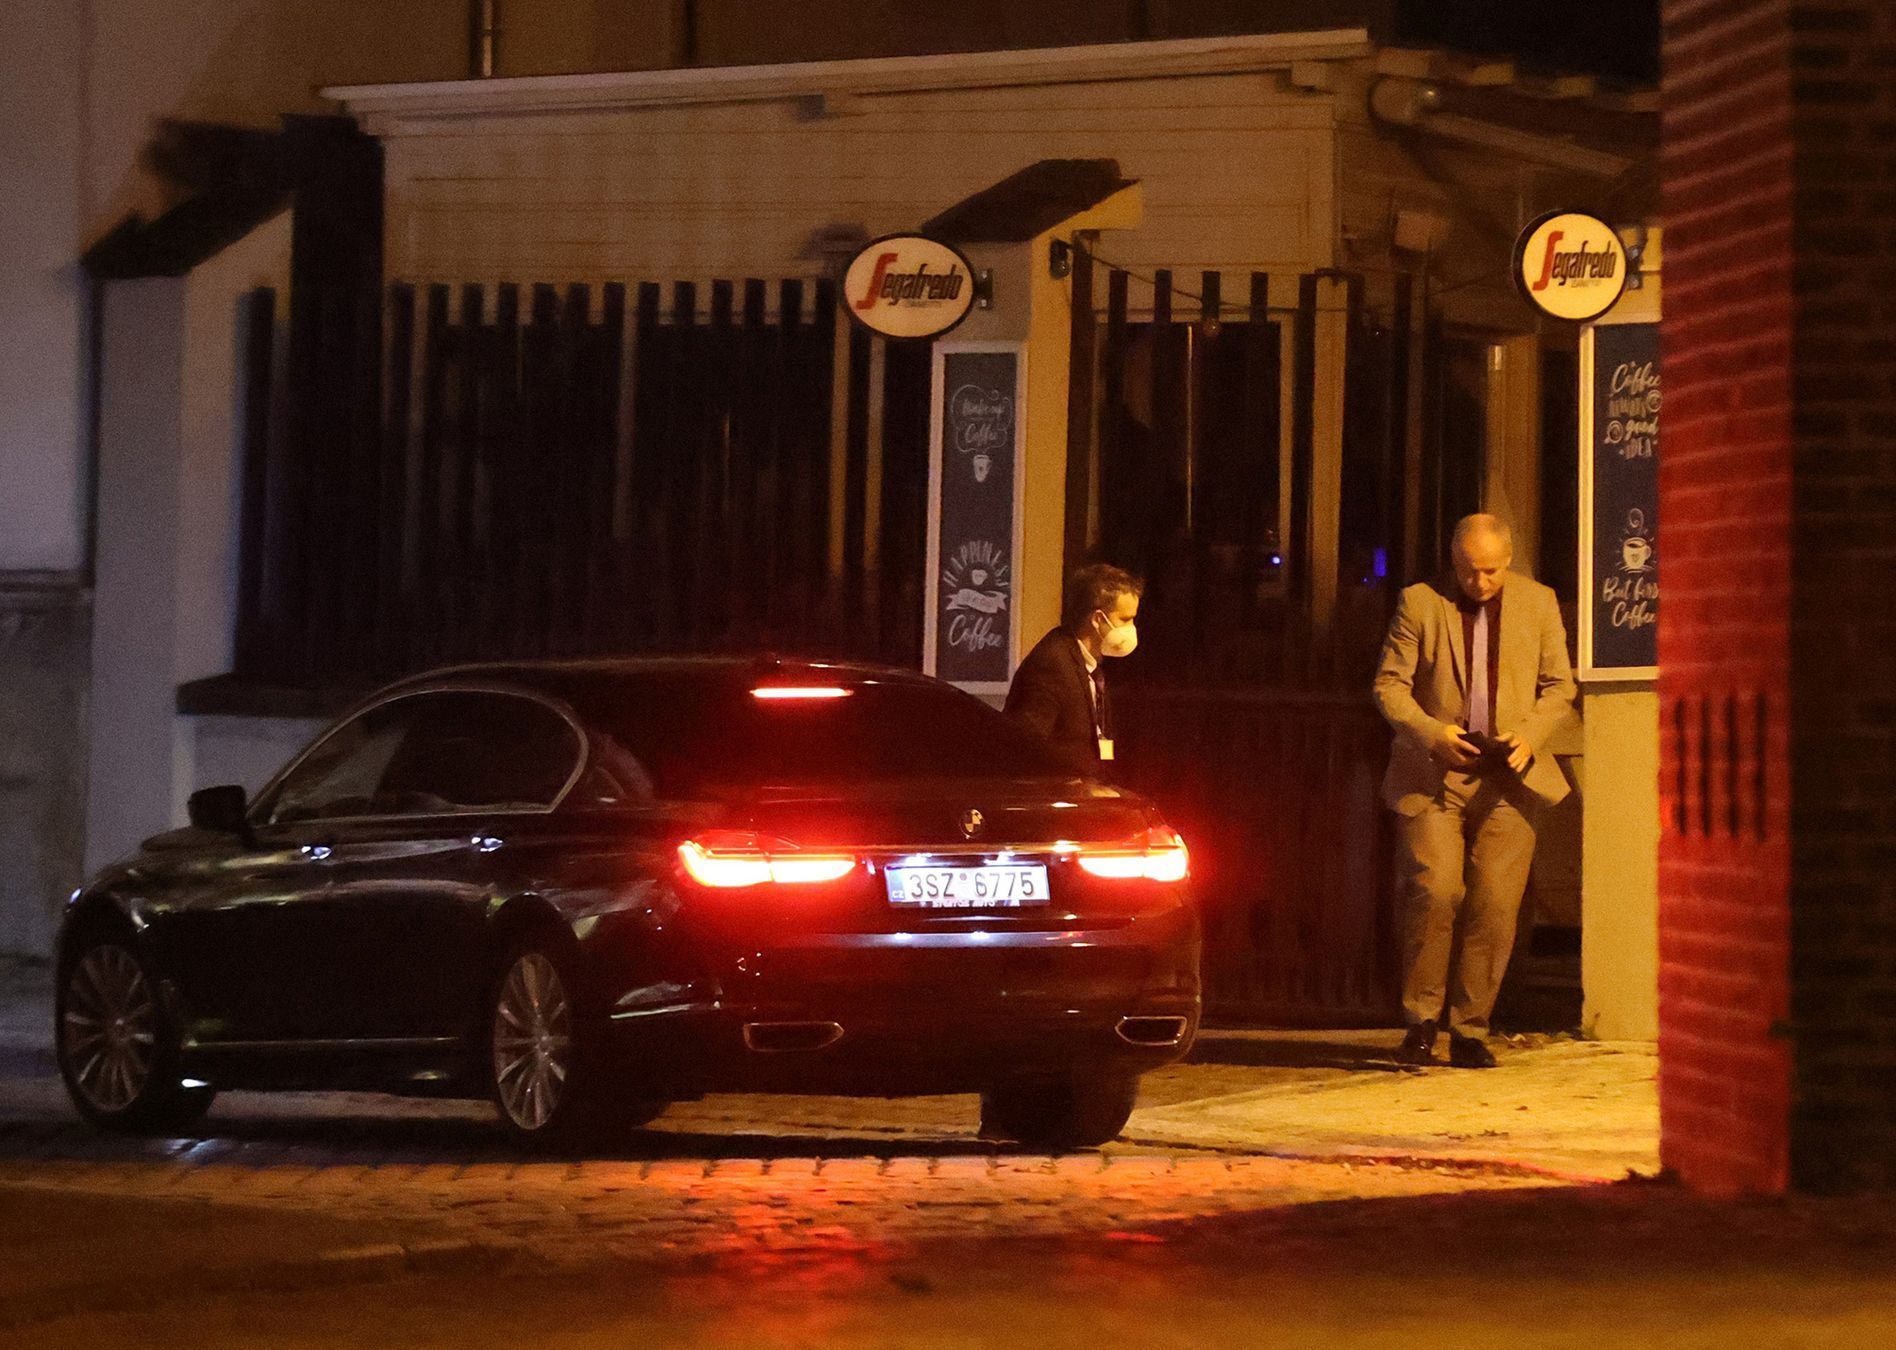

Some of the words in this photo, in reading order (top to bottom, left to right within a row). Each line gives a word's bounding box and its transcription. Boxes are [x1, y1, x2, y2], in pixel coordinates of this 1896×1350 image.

[1532, 231, 1617, 291] Segafredo
[856, 252, 963, 310] Segafredo
[949, 614, 1002, 652] Coffee
[1612, 600, 1656, 630] Coffee
[909, 872, 955, 899] 3SZ
[973, 871, 1035, 898] 6775
